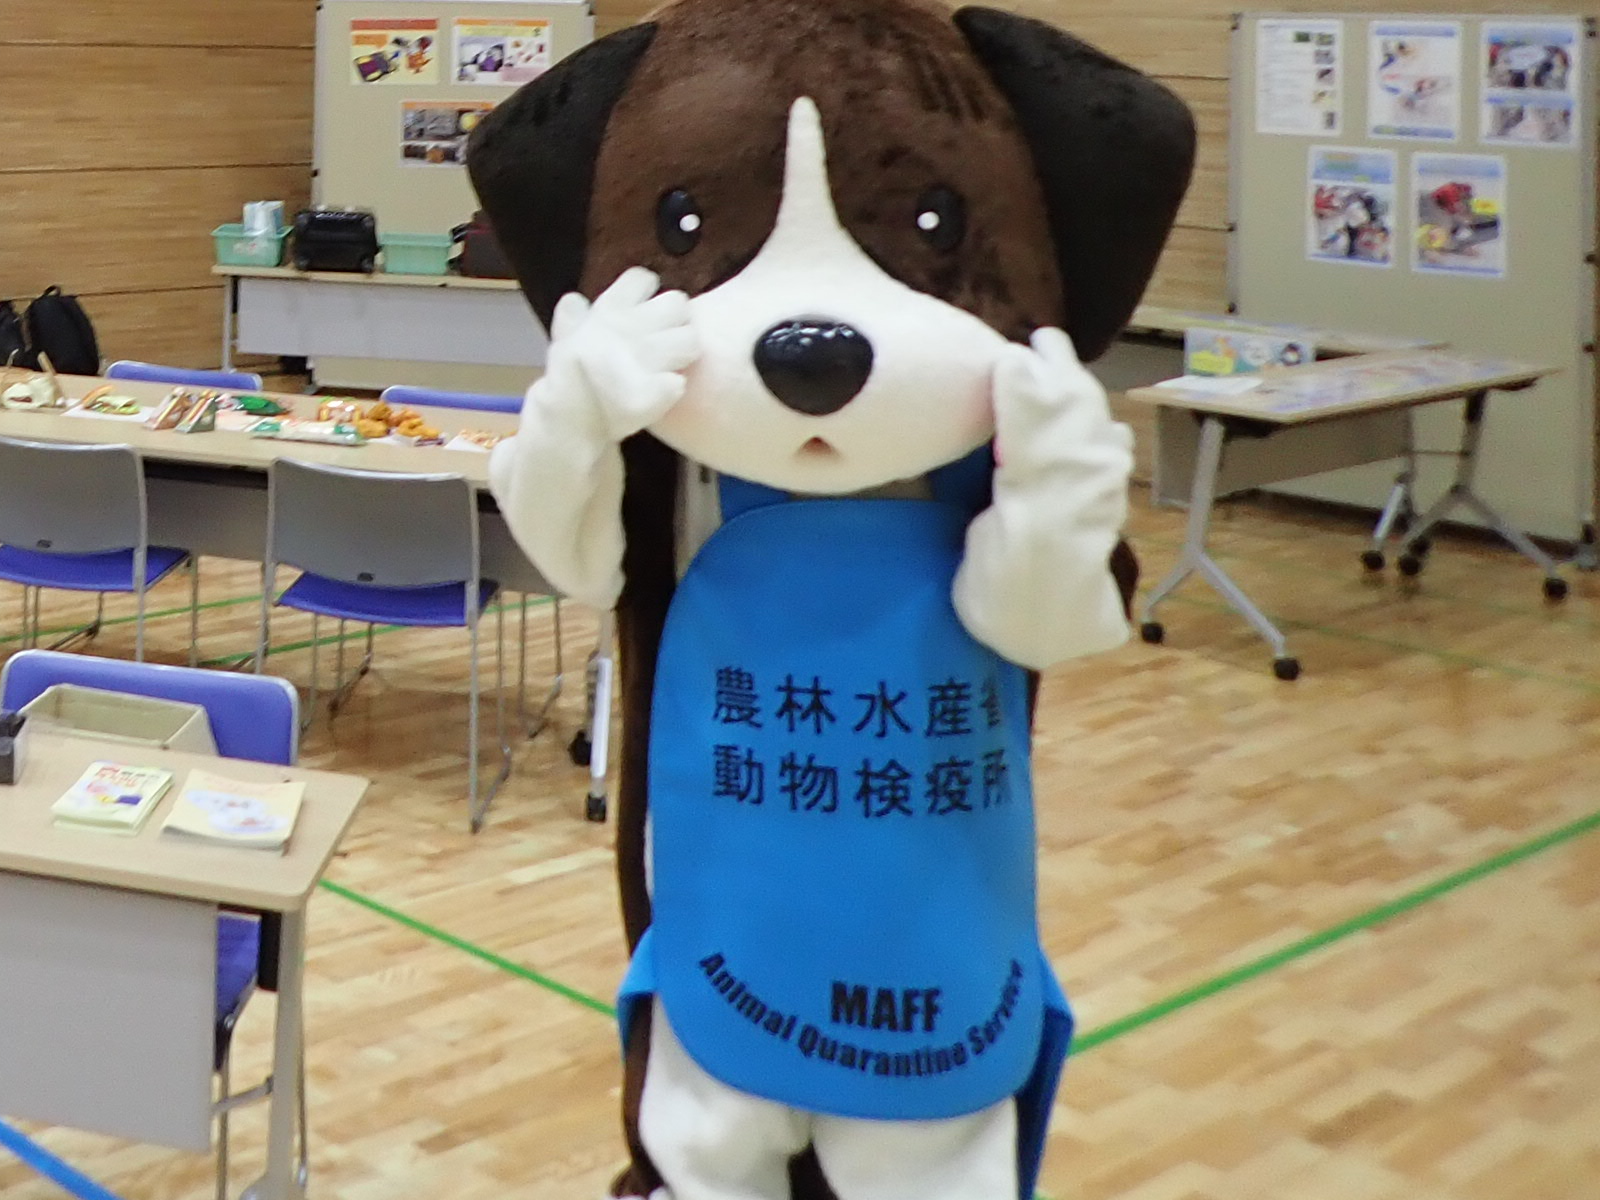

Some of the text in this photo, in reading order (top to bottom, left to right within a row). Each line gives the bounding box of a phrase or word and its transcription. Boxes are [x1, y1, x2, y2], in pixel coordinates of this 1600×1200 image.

[699, 952, 796, 1042] Animal
[799, 1024, 968, 1078] Quarantine
[831, 982, 942, 1033] MAFF
